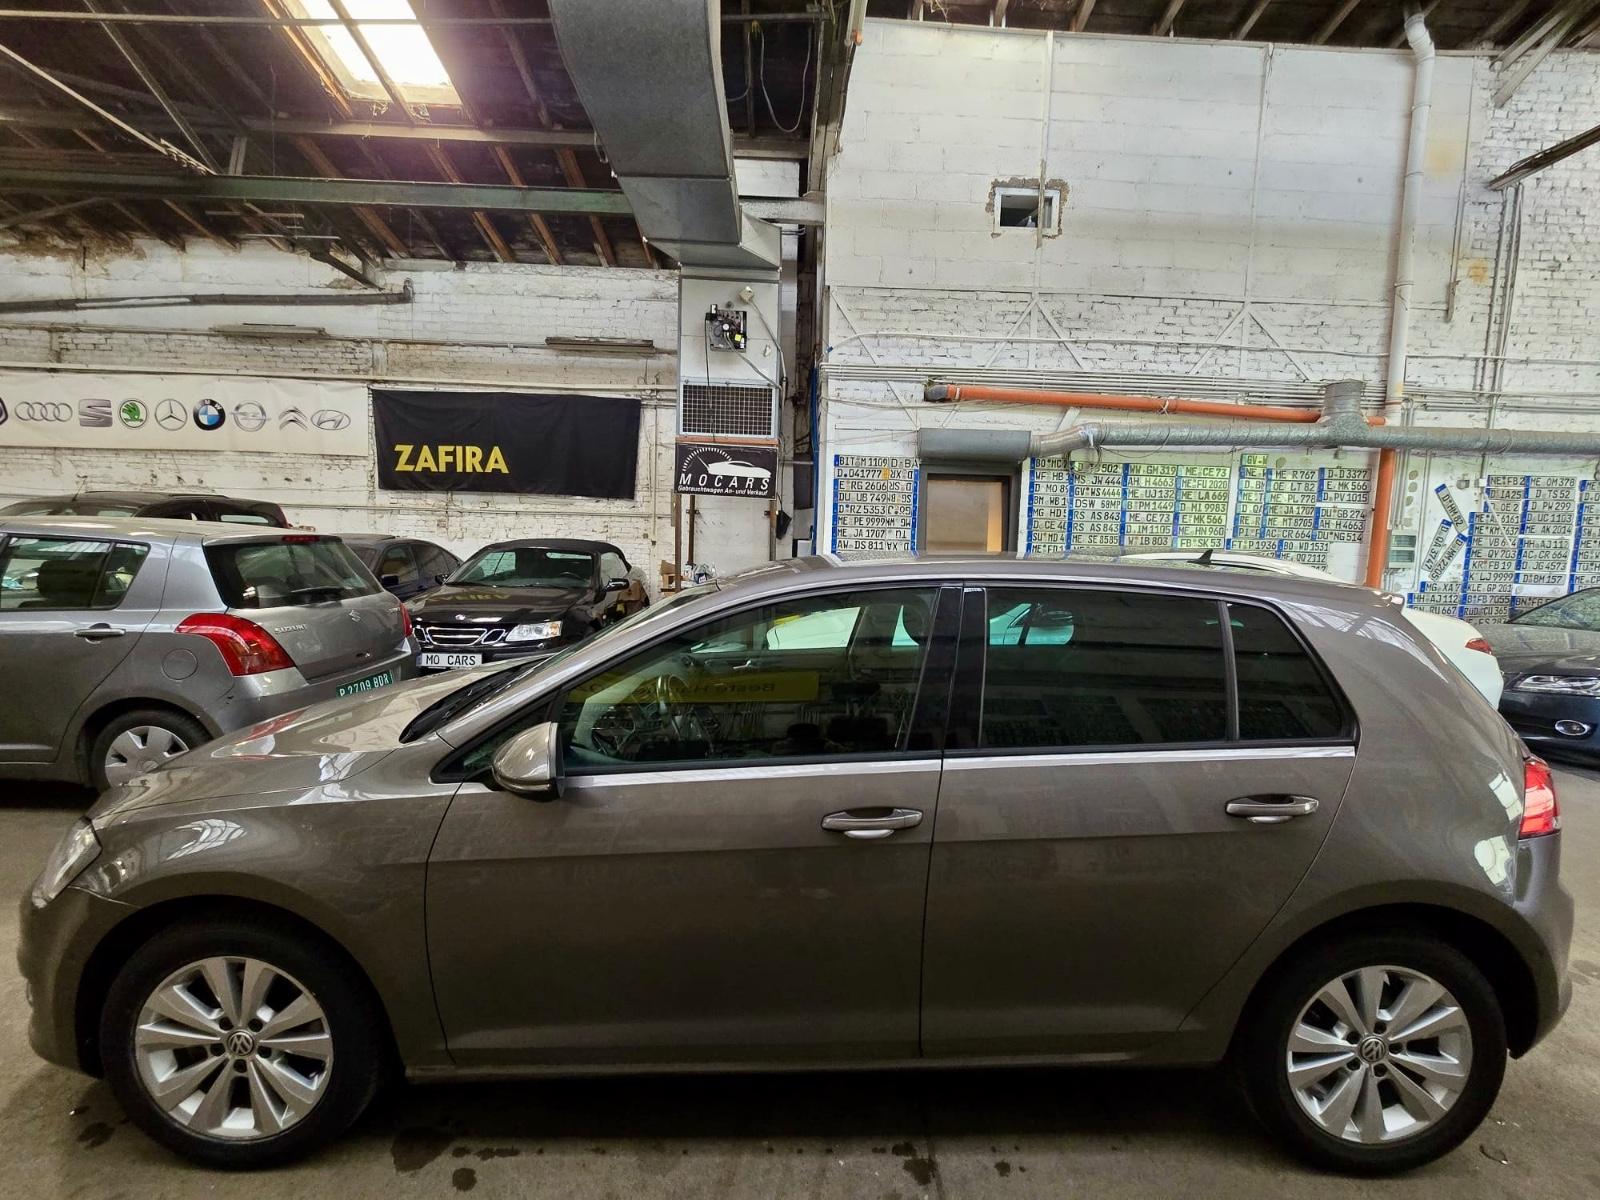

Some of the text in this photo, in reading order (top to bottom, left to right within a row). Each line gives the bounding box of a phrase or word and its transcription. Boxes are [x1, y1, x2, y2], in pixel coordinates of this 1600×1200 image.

[394, 444, 510, 474] ZAFIRA
[426, 655, 477, 666] MO CARS
